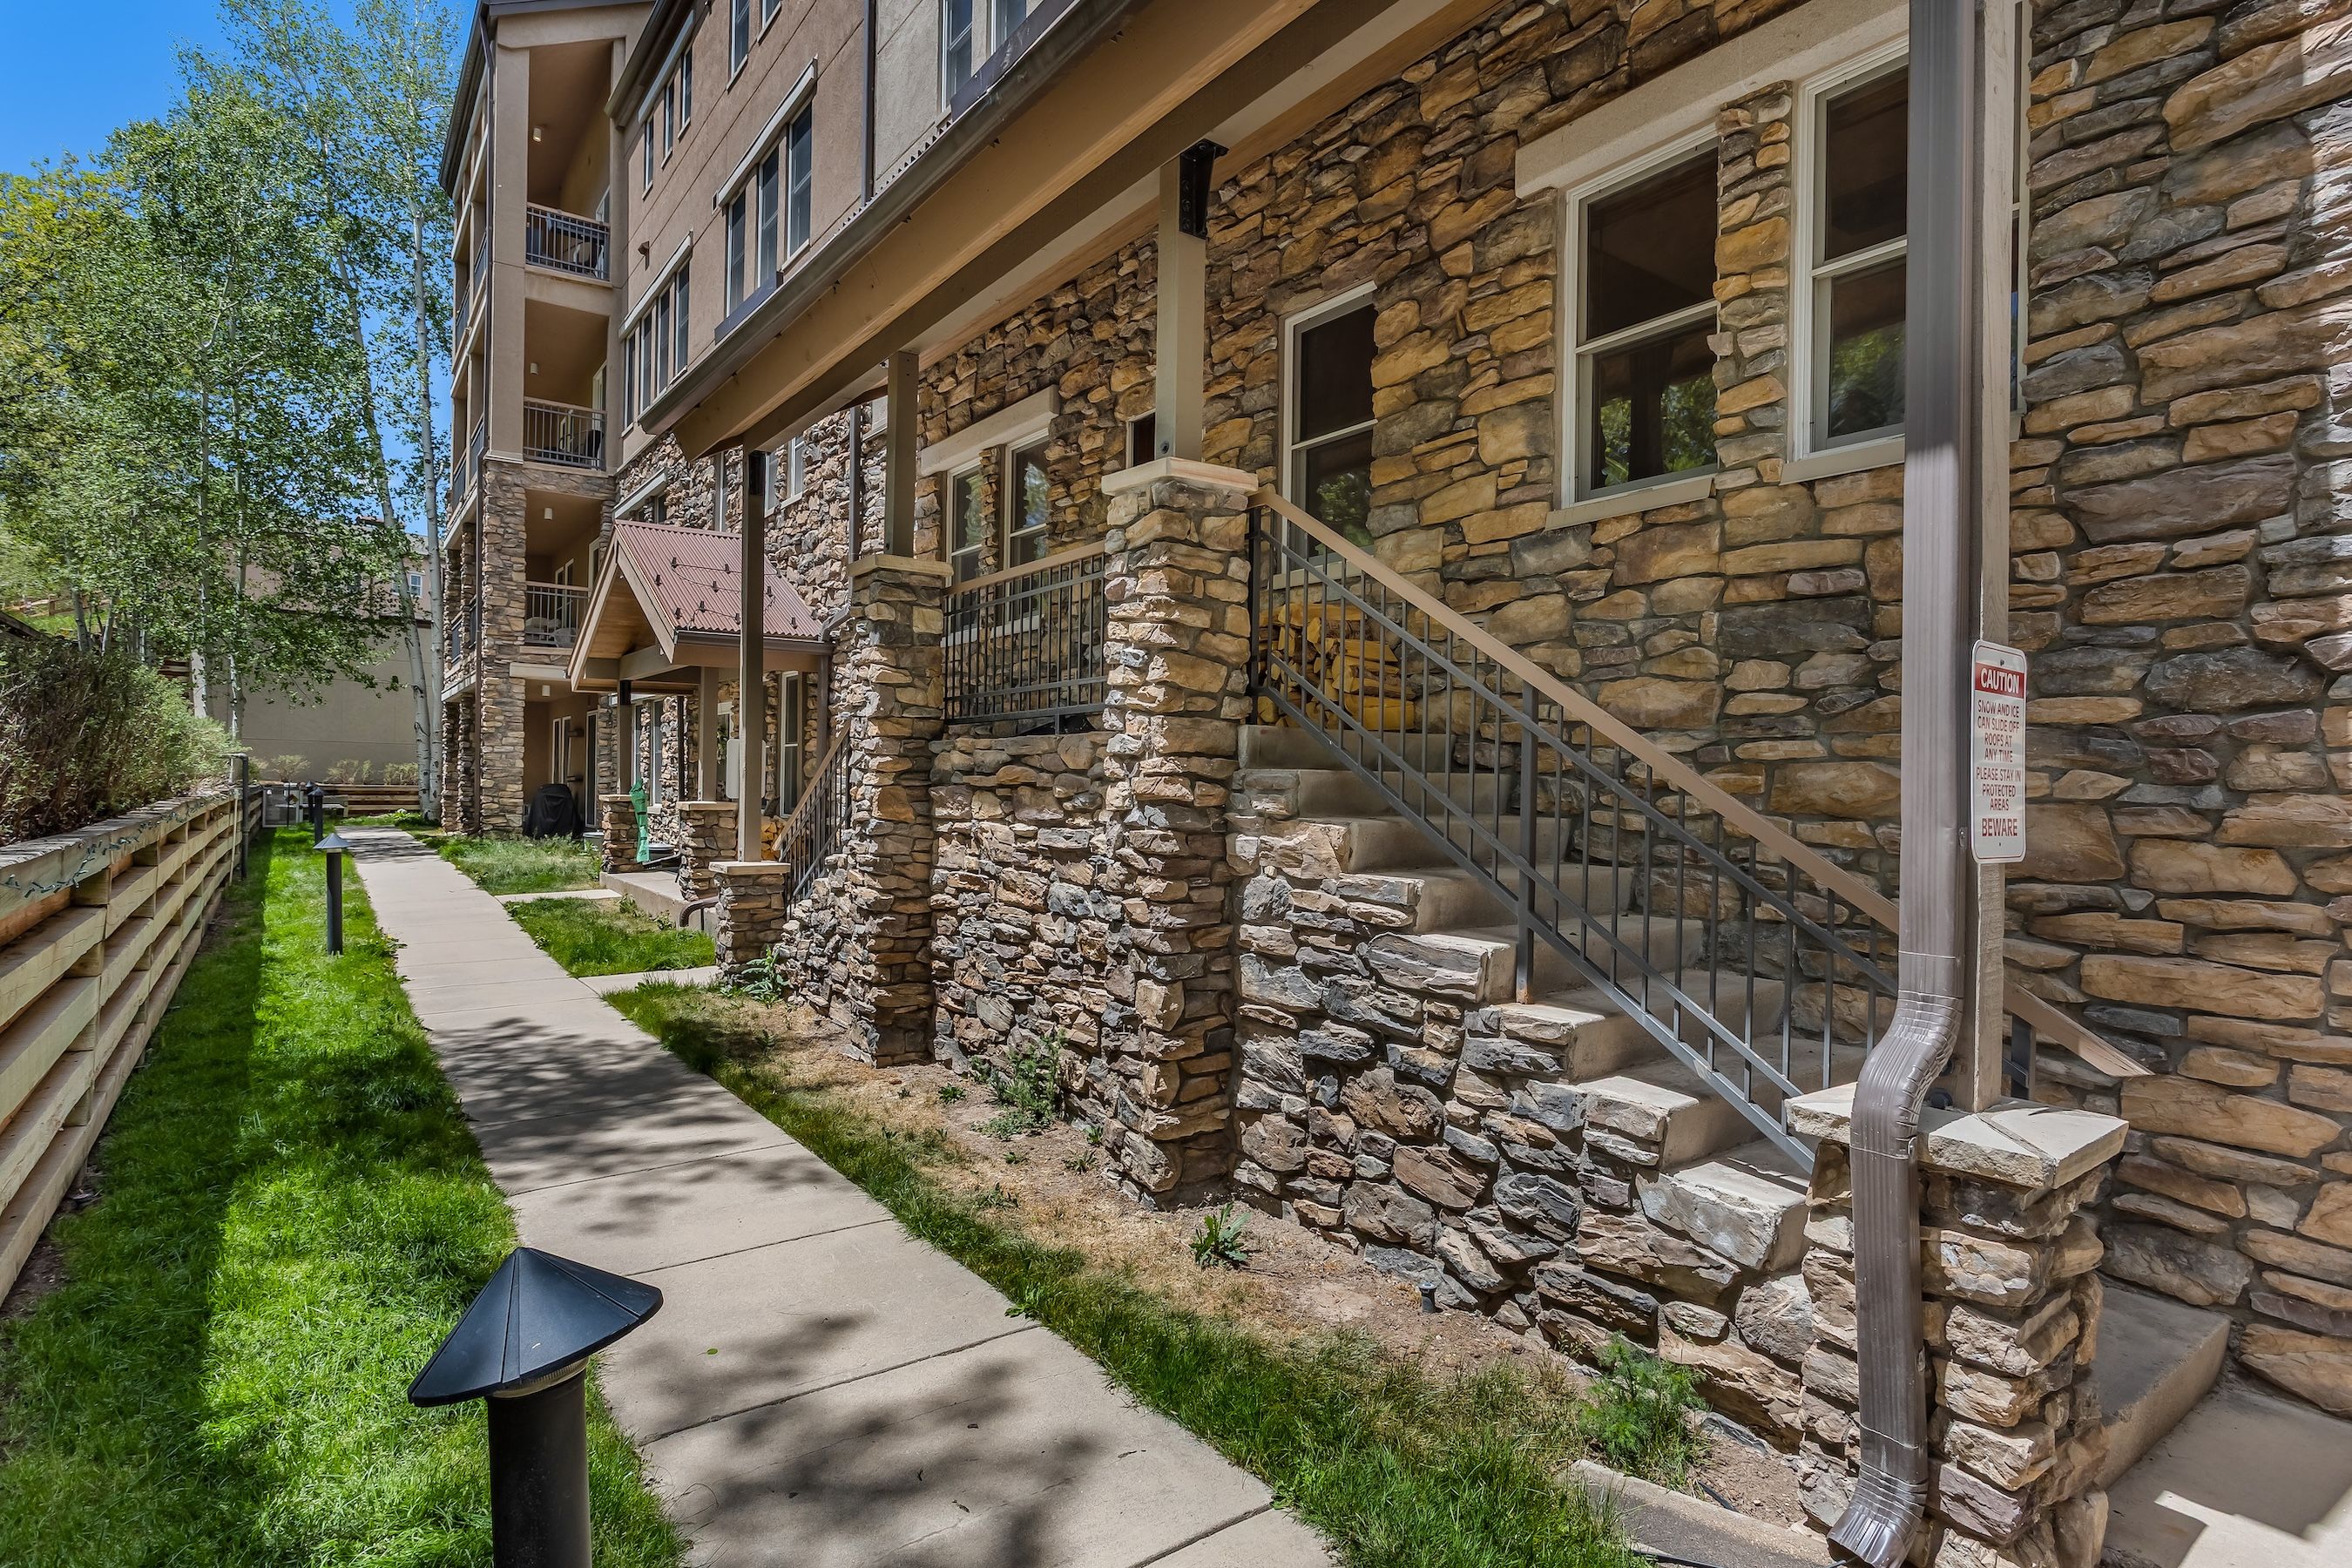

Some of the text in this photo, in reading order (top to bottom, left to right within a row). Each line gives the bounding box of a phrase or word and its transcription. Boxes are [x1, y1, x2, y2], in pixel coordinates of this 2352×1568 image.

[1980, 667, 2020, 694] CAUTION
[1977, 700, 2019, 718] SNOW AND ICE
[1977, 715, 2019, 733] CAN SLIDE OFF
[1984, 733, 2012, 747] ROOFS AT
[1984, 748, 2013, 763] ANY TIME
[1976, 767, 2021, 782] PLEASE STAY IN
[1982, 784, 2017, 797] PROTECTED
[1990, 798, 2010, 811] AREAS
[1982, 818, 2017, 836] BEWARE
